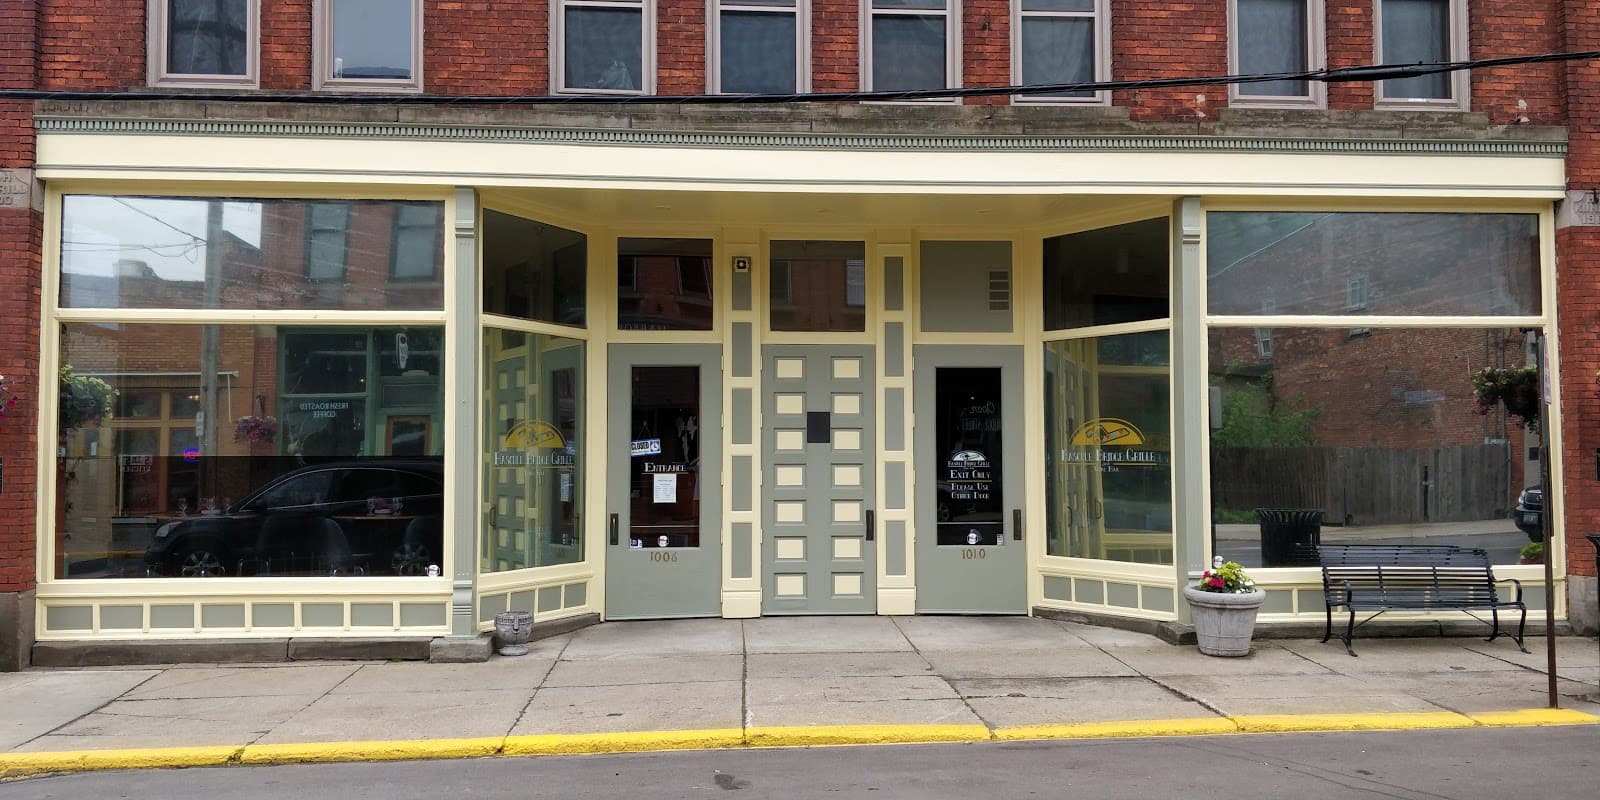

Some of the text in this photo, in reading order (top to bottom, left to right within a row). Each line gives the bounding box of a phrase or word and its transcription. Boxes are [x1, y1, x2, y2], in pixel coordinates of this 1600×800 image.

[1126, 448, 1156, 461] GRILLE
[644, 462, 687, 472] ENTRANCE
[950, 470, 969, 478] EXIT
[962, 549, 986, 560] 1010
